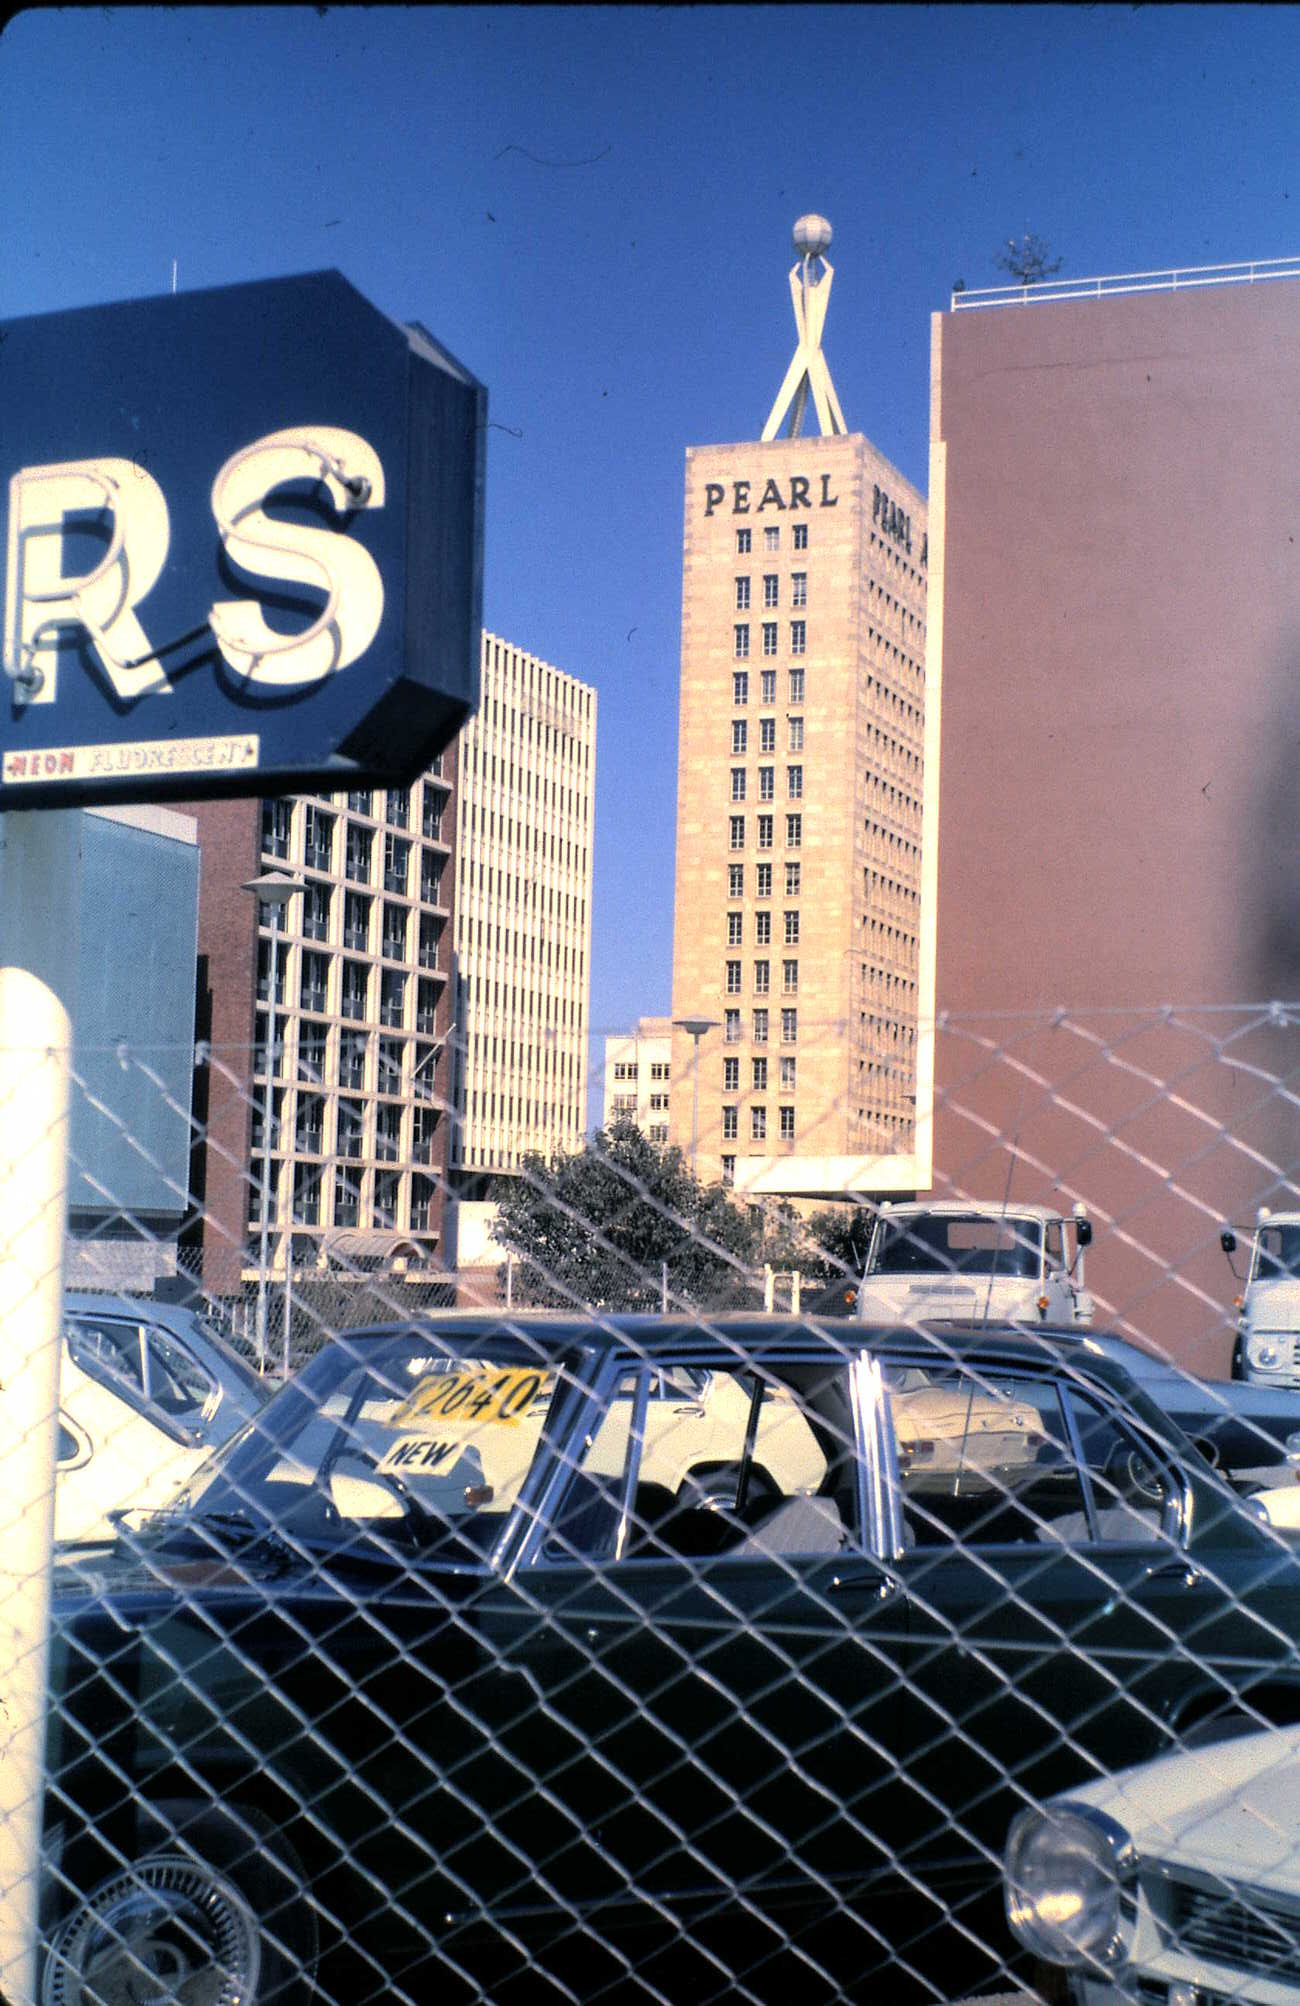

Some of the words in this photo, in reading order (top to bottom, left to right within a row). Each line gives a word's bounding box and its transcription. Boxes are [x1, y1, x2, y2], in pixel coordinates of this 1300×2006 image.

[704, 474, 839, 517] PEARL
[12, 752, 75, 777] NEON
[387, 1440, 459, 1467] NEW
